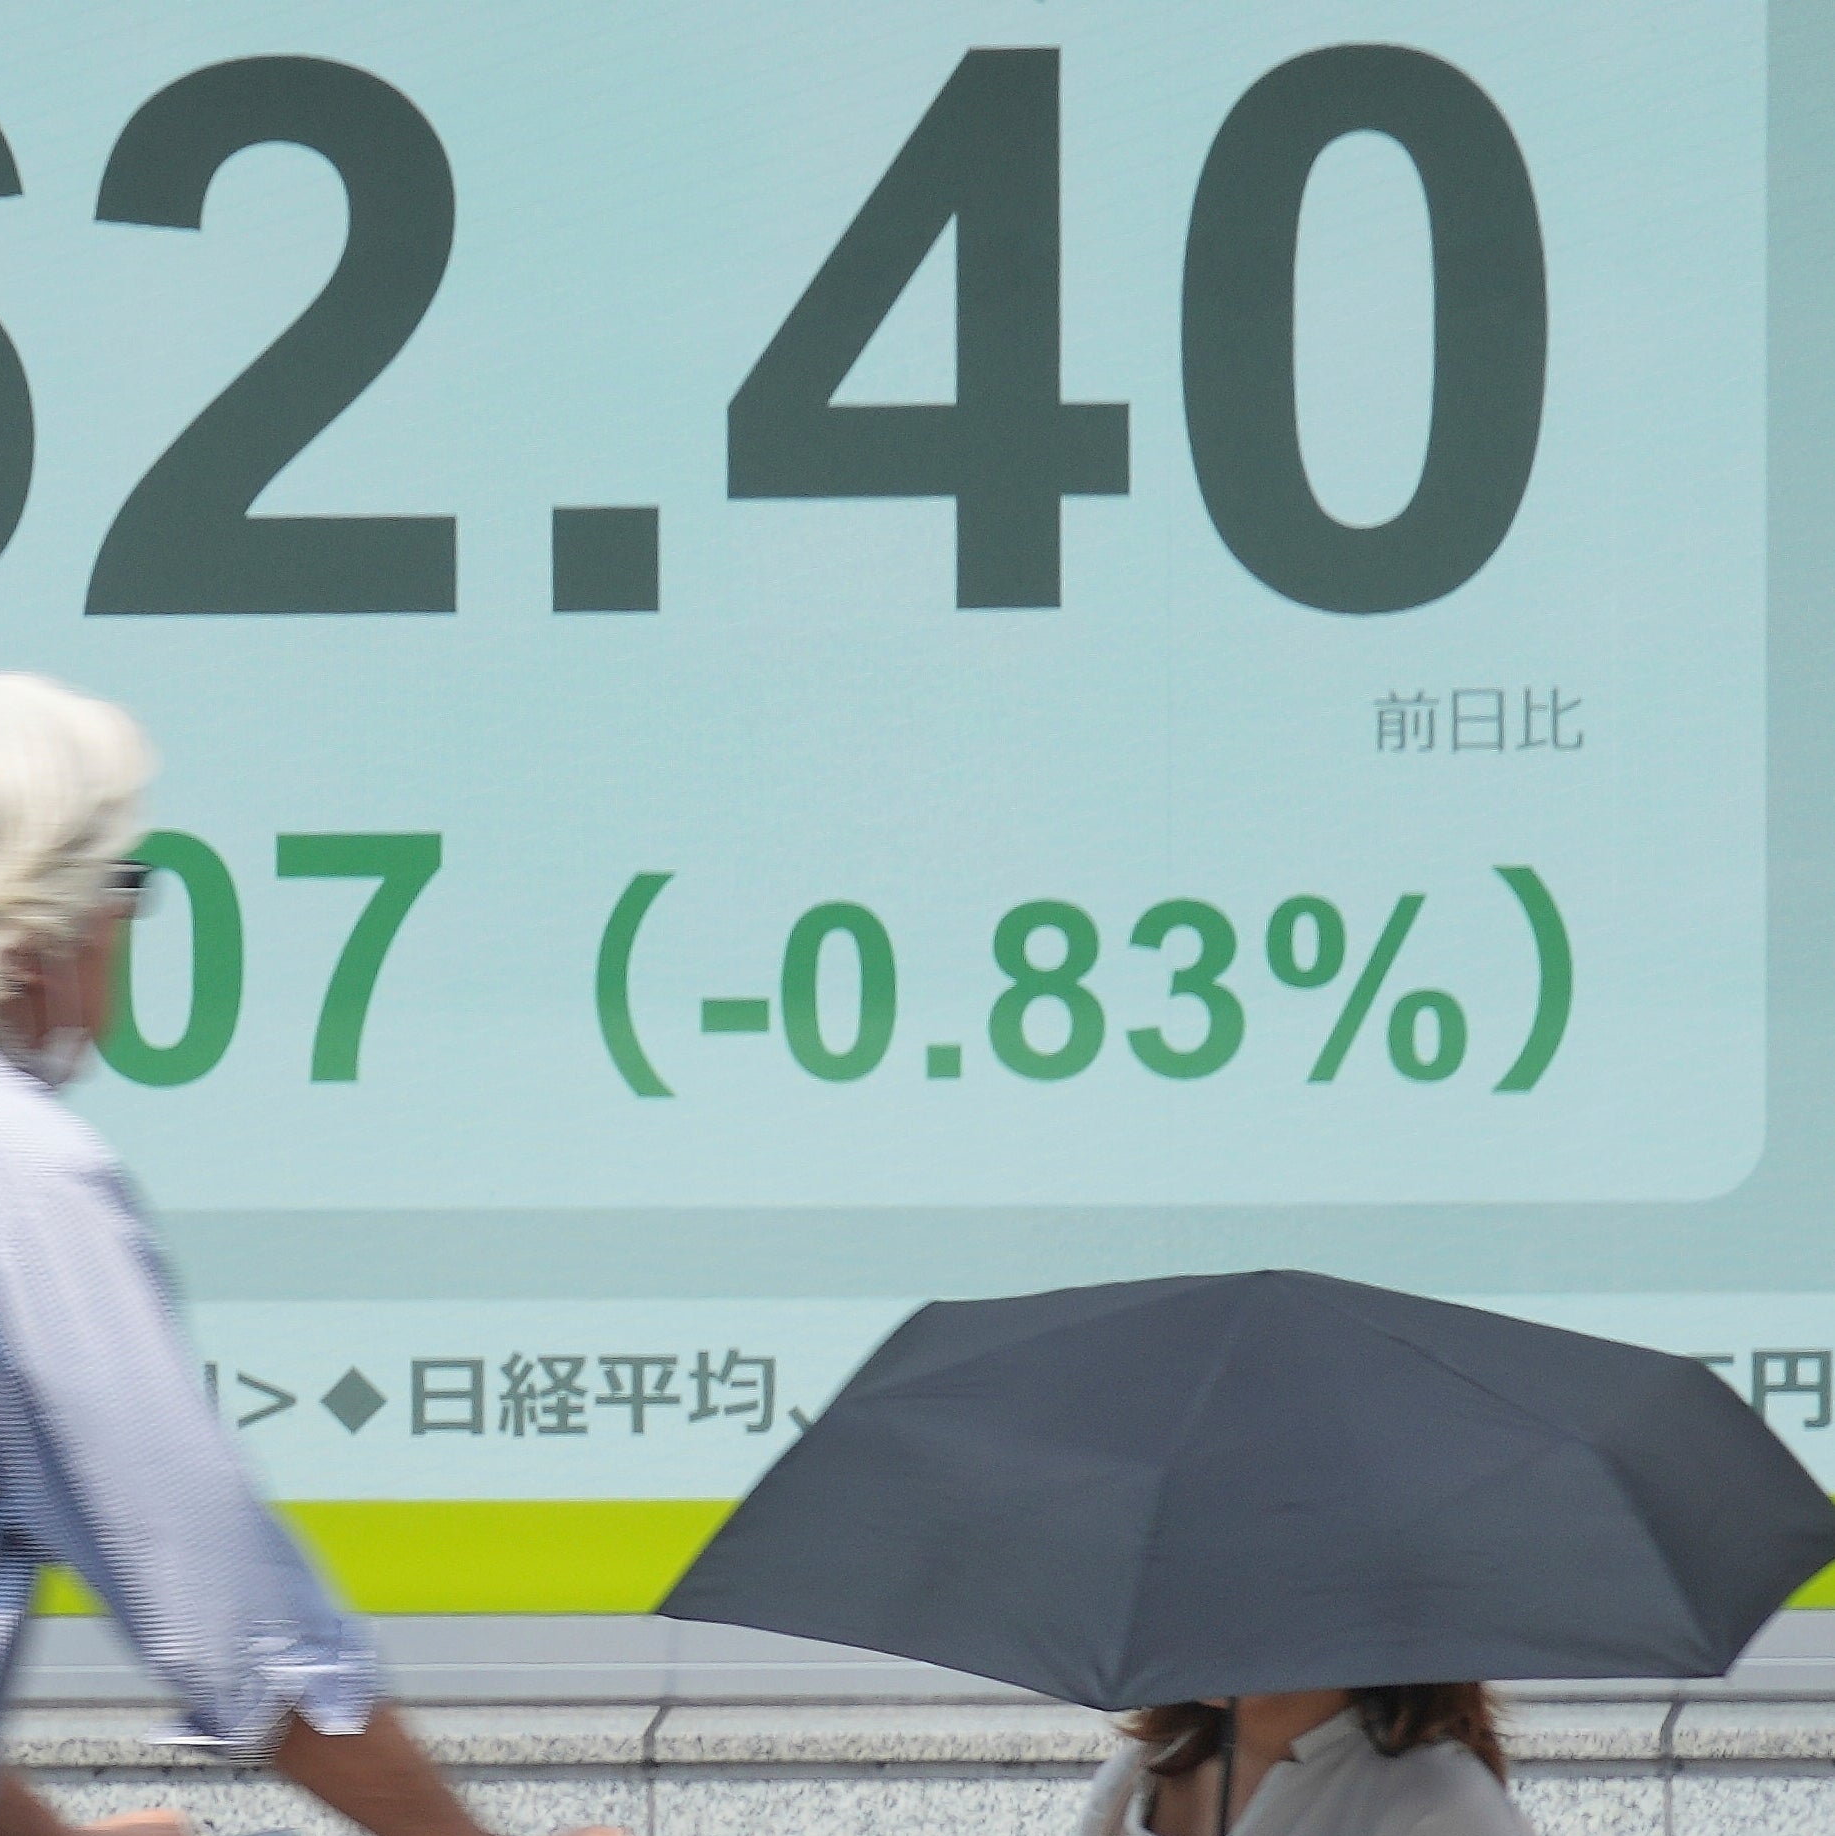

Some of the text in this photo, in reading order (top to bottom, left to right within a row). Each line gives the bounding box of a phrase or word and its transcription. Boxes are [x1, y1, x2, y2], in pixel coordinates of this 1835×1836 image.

[1374, 687, 1586, 754] 前日比
[595, 867, 1575, 1099] (-0.83%)
